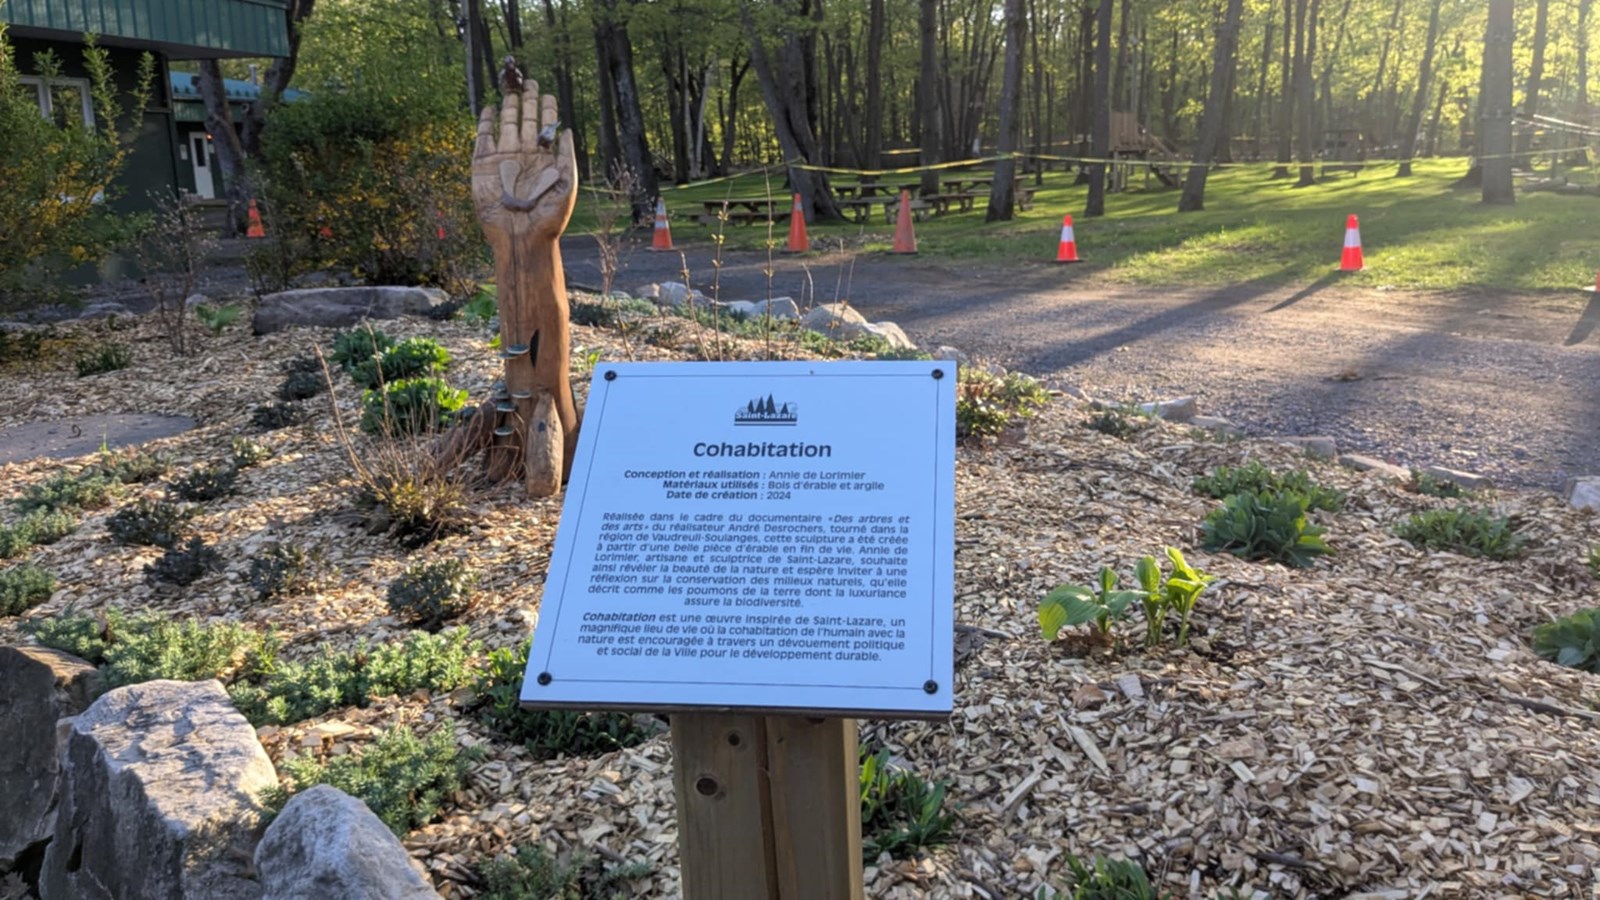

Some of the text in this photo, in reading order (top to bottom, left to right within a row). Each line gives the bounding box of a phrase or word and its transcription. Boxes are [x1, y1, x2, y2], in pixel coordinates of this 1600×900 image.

[693, 440, 832, 458] Cohabitation
[624, 470, 686, 480] Conception
[688, 471, 700, 479] et
[702, 471, 760, 479] réalisation
[768, 471, 800, 480] Annie
[803, 471, 817, 480] de
[820, 472, 866, 480] Lorimier
[662, 480, 718, 489] Matériaux
[720, 481, 759, 490] utilisés
[768, 481, 791, 490] Bois
[793, 481, 837, 490] d'érable
[839, 482, 851, 490] et
[853, 482, 884, 492] argile
[666, 491, 692, 499] Date
[694, 491, 709, 499] de
[711, 491, 758, 500] création
[766, 491, 791, 500] 2024
[602, 512, 645, 521] Réalisée
[649, 513, 674, 522] dans
[679, 513, 689, 522] le
[694, 513, 724, 522] cadre
[728, 514, 743, 522] du
[748, 514, 822, 523] documentaire
[858, 515, 893, 524] arbres
[898, 516, 910, 524] et
[601, 522, 620, 531] des
[652, 523, 666, 532] du
[669, 523, 726, 532] réalisateur
[728, 524, 760, 533] André
[764, 524, 826, 535] Desrochers,
[830, 525, 867, 534] tourné
[870, 525, 896, 534] dans
[900, 526, 909, 534] la
[598, 532, 633, 543] région
[635, 533, 649, 542] de
[652, 533, 761, 545] Vaudreuil-Soulanges,
[764, 534, 792, 544] cette
[794, 535, 846, 546] sculpture
[857, 535, 876, 544] été
[878, 536, 908, 545] créée
[596, 543, 603, 551] à
[606, 543, 637, 553] partir
[639, 543, 670, 552] d'une
[673, 544, 699, 552] belle
[702, 544, 732, 554] pièce
[735, 544, 779, 554] d'érable
[800, 545, 815, 554] fin
[818, 545, 833, 554] de
[836, 546, 854, 554] vie.
[858, 546, 890, 555] Annie
[894, 546, 908, 555] de
[594, 553, 908, 567] Lorimier, artisane et sculptrice de Saint-Lazare, souhaite
[592, 563, 908, 577] ainsi révéler la beauté de la nature et espère inviter à une
[590, 574, 638, 583] réflexion
[662, 575, 672, 584] la
[676, 575, 746, 585] conservation
[750, 576, 770, 585] des
[773, 577, 814, 586] milieux
[817, 577, 865, 588] naturels,
[869, 578, 907, 589] qu'elle
[588, 585, 907, 598] décrit comme les poumons de la terre dont la luxuriance
[723, 598, 732, 607] la
[735, 598, 803, 608] biodiversité.
[582, 612, 906, 628] Cohabitation est une œuvre inspirée de Saint-Lazare, un
[580, 623, 905, 638] magnifique lieu de vie où la cohabitation de l'humain avec la
[578, 635, 905, 652] nature est encouragée à travers un dévouement politique
[596, 646, 881, 662] et social de la Ville pour le développement durable.
